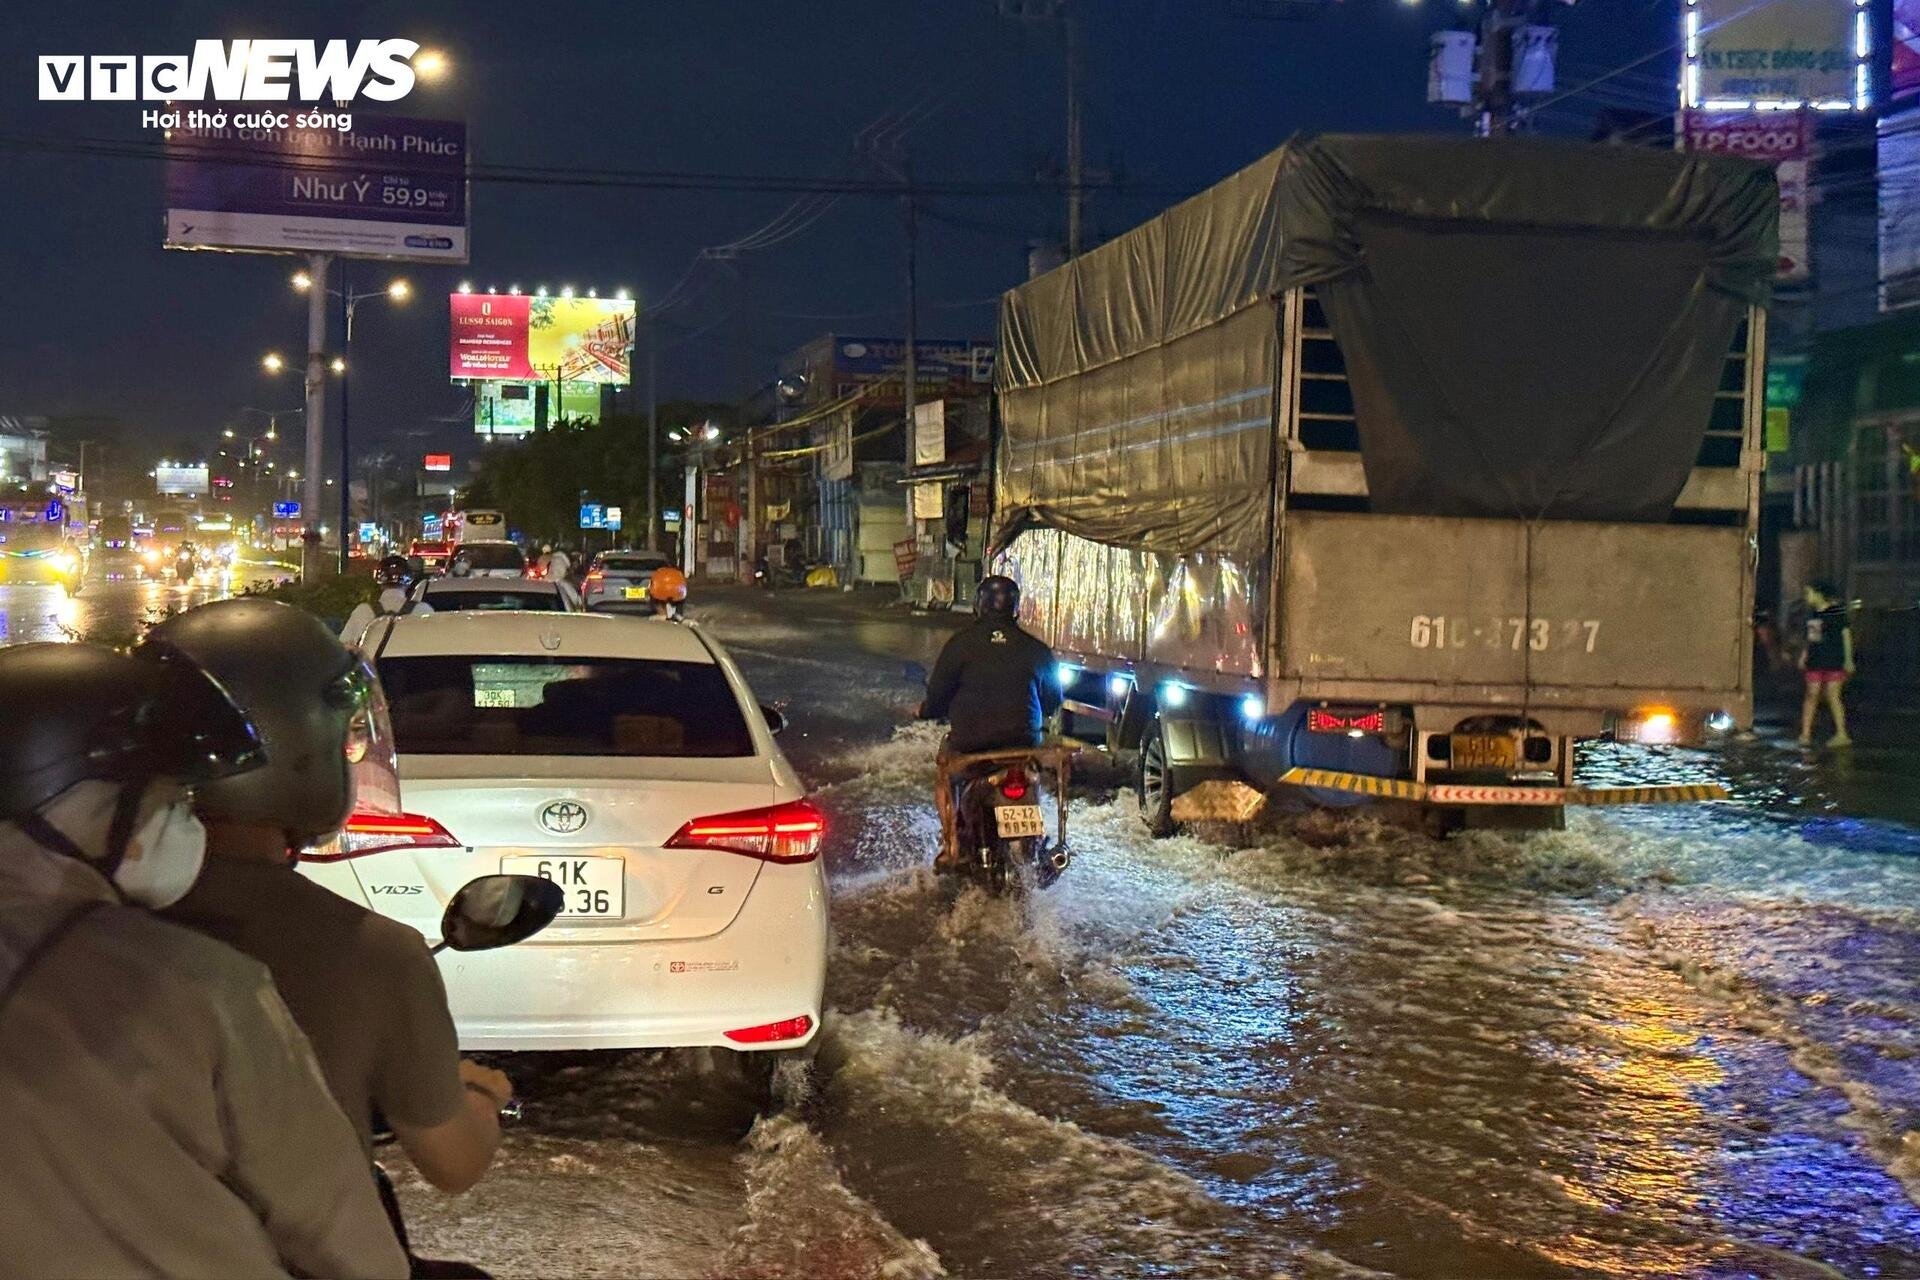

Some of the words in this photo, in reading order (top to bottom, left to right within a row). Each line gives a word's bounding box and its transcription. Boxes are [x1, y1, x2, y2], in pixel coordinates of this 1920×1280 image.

[339, 131, 396, 151] Hạnh
[403, 134, 459, 155] Phúc
[293, 176, 347, 200] Như
[353, 174, 370, 202] Ý
[383, 187, 427, 207] 59,9
[485, 317, 513, 326] SAIGON
[538, 861, 588, 885] 61K
[370, 885, 425, 895] VIOS
[707, 886, 725, 895] G
